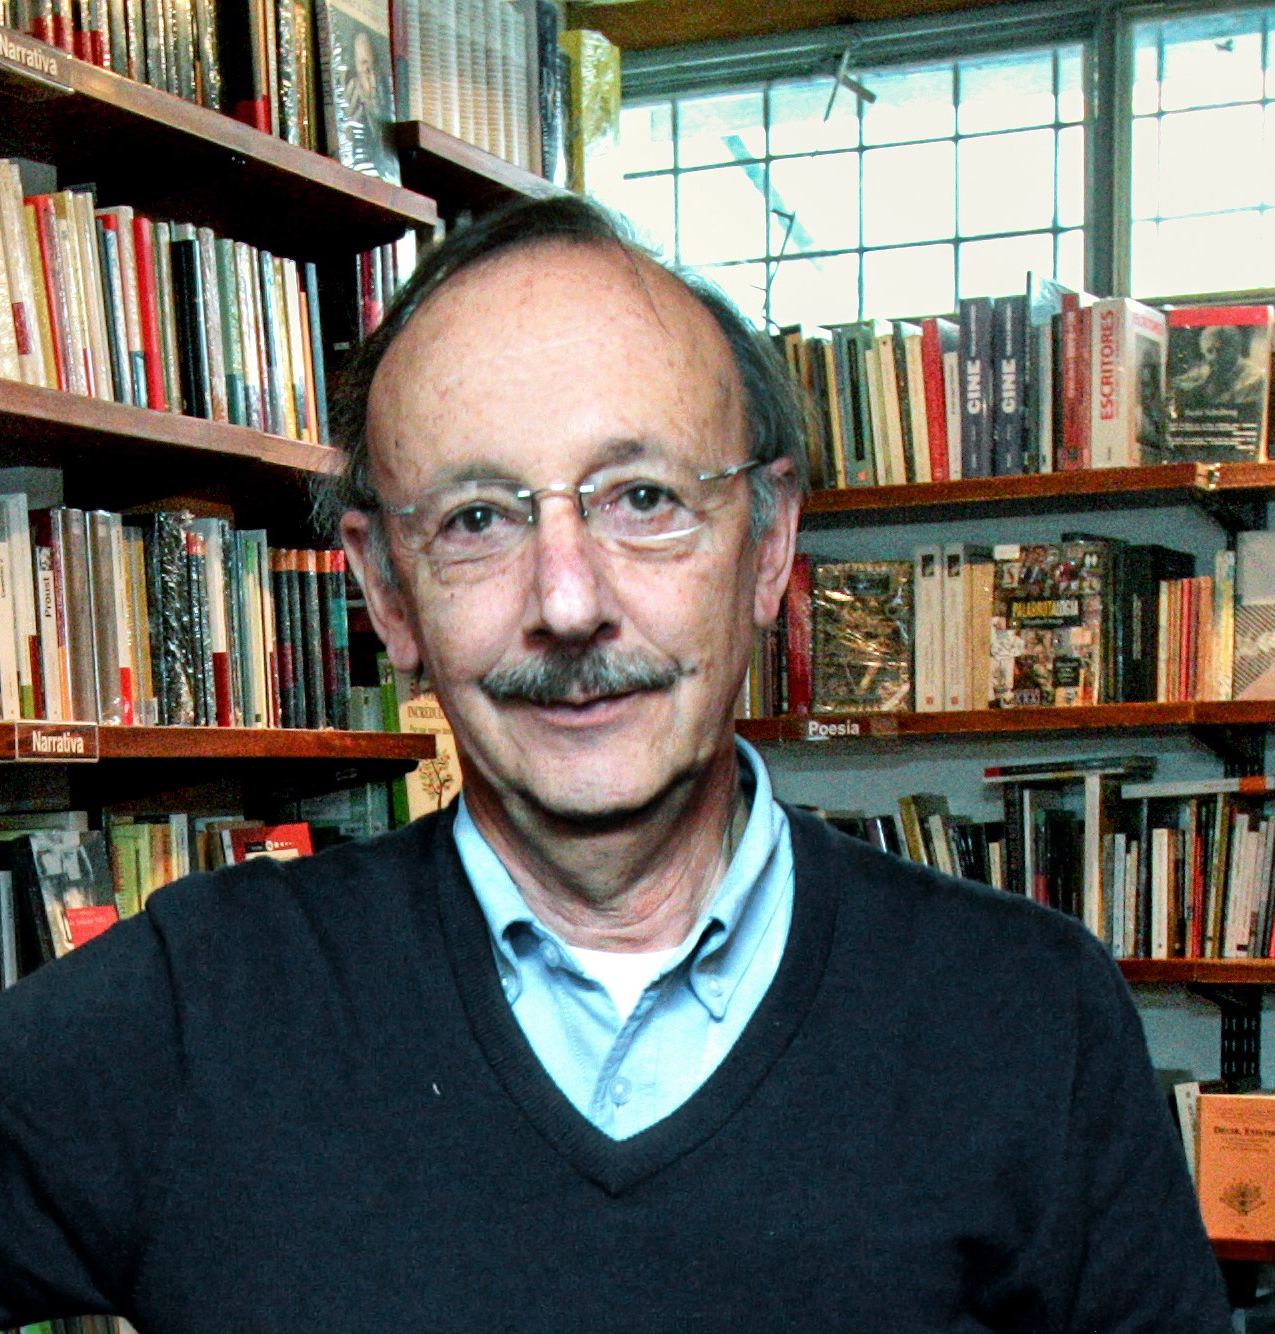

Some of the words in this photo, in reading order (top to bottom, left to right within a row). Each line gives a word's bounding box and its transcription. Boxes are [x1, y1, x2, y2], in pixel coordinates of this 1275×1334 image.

[965, 357, 983, 416] CINE
[1001, 357, 1018, 414] CINE
[1099, 308, 1116, 421] ESCRITORES
[44, 576, 53, 618] Proust
[32, 730, 84, 754] Narrativa
